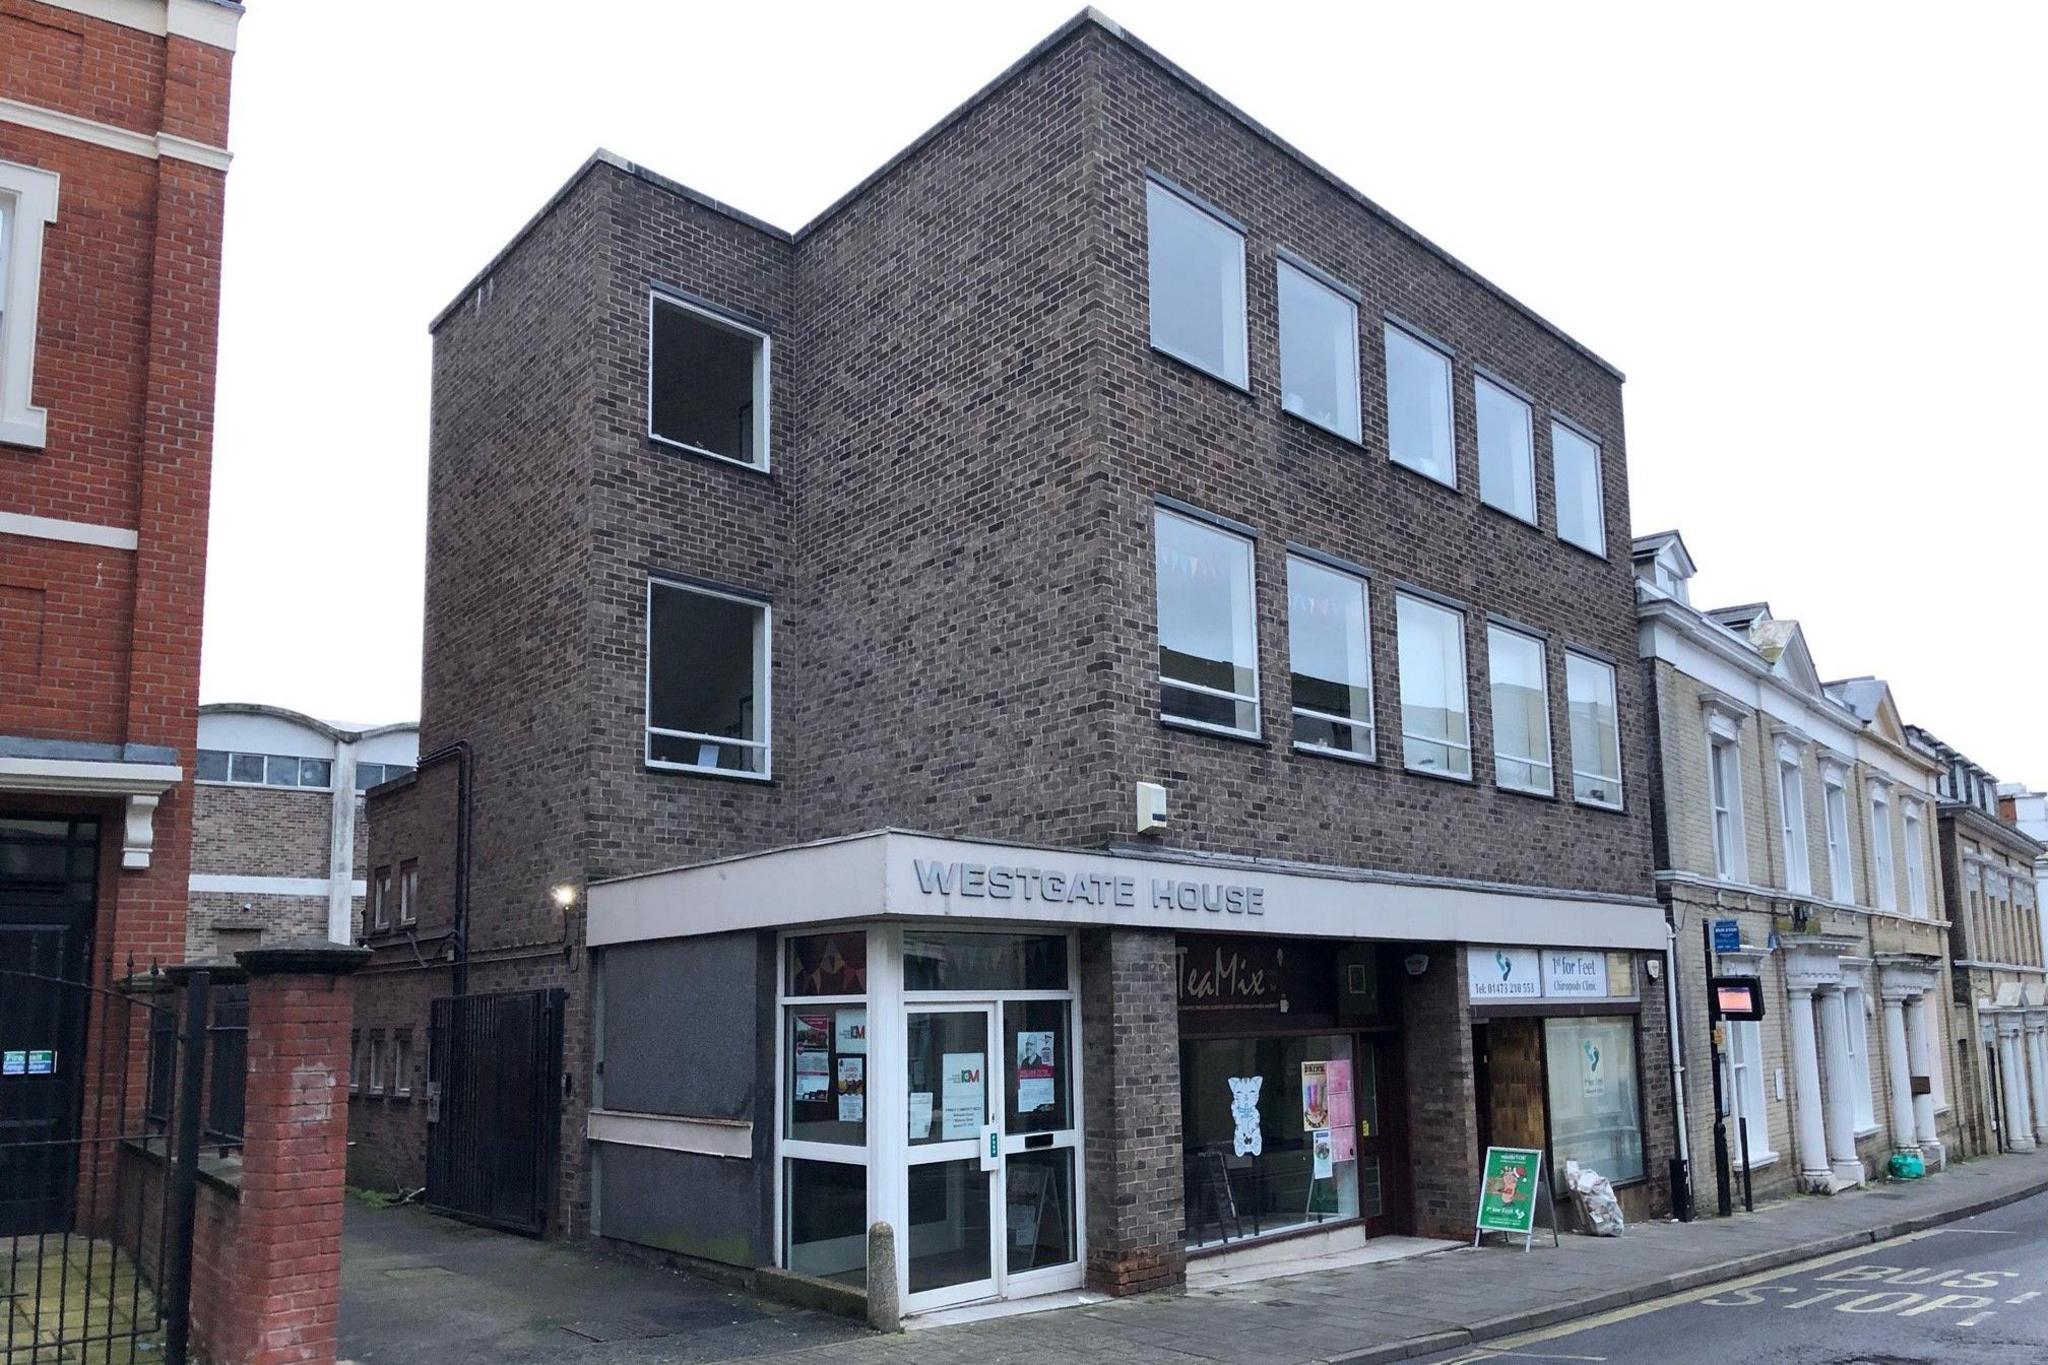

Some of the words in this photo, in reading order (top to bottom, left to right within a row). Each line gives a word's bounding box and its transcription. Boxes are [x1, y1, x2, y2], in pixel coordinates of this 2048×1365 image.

[914, 858, 1136, 907] WESTGATE
[1151, 878, 1265, 915] HOUSE
[1562, 956, 1576, 975] for
[1578, 957, 1596, 975] Feet
[1813, 1265, 2019, 1288] BUS
[1700, 1286, 1995, 1317] STOP
